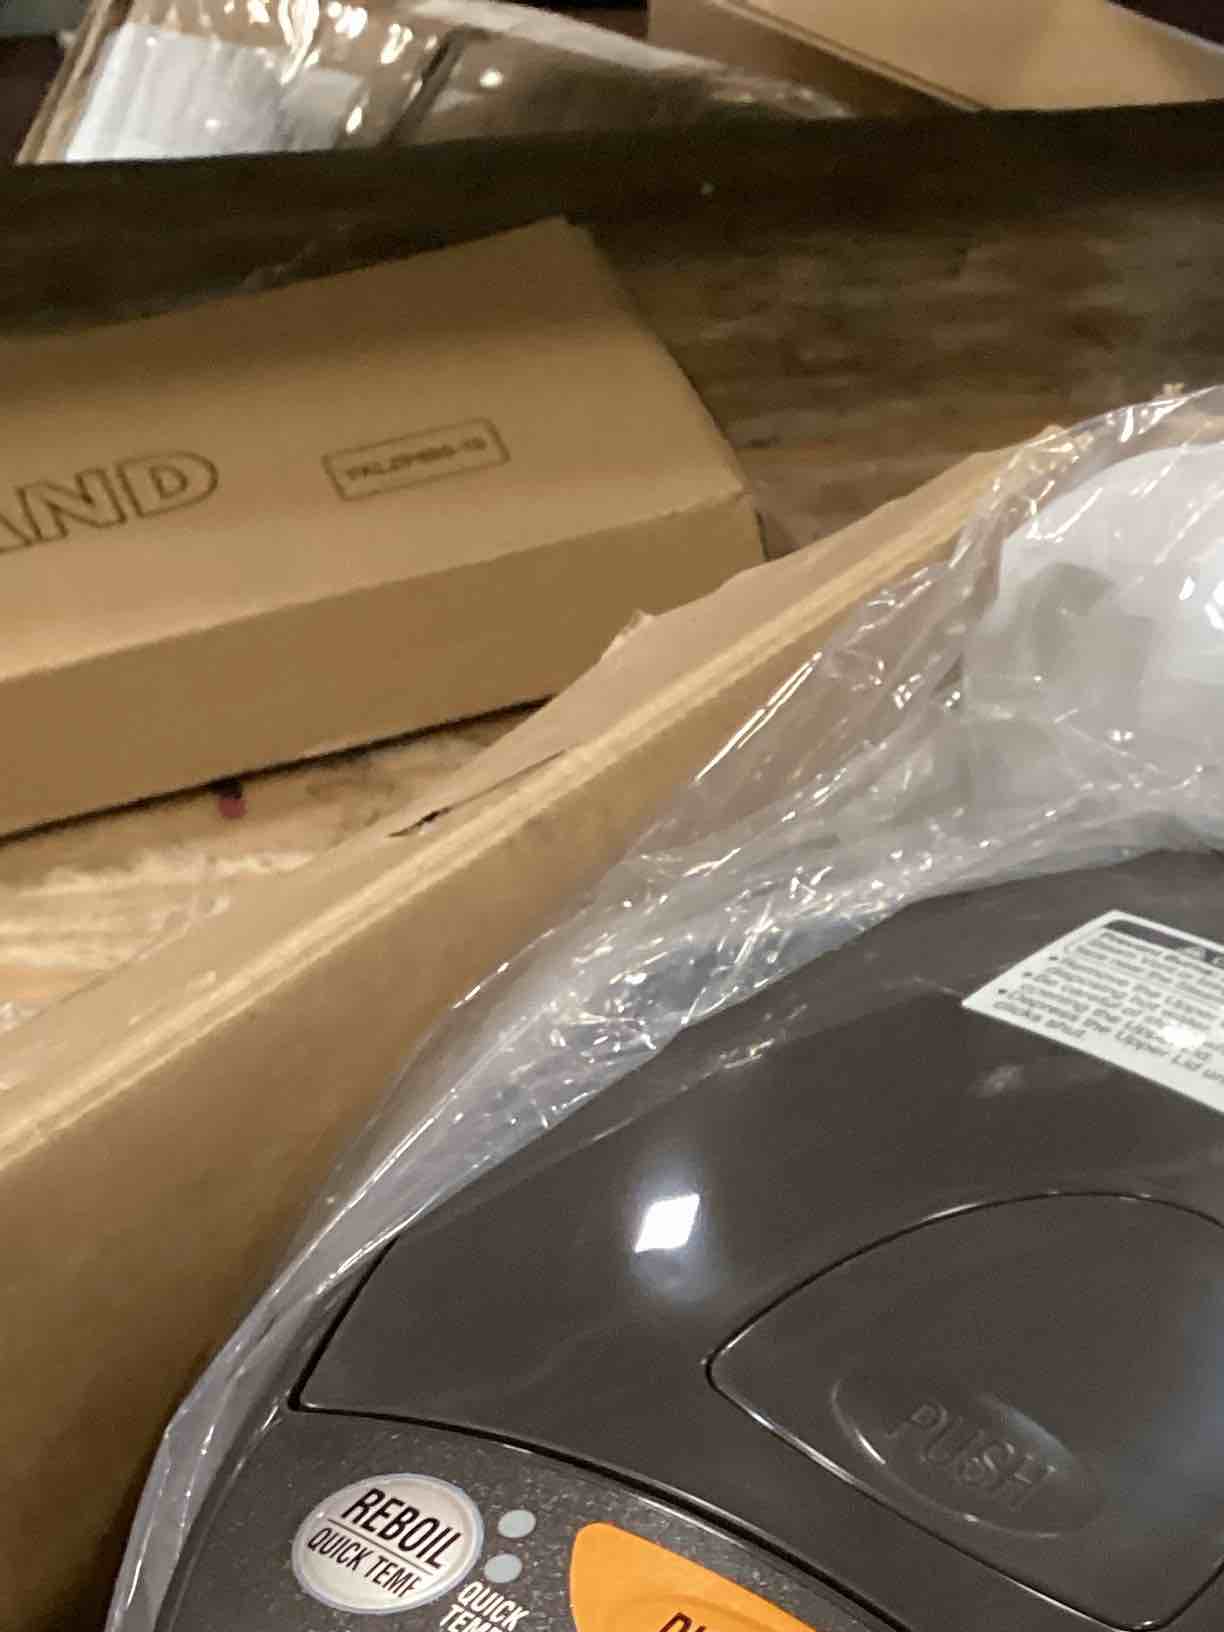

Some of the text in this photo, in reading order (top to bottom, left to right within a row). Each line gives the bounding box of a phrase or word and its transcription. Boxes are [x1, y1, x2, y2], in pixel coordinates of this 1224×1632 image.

[308, 1527, 365, 1571] QUICK
[342, 1488, 461, 1570] REBOIL
[457, 1581, 530, 1632] QUICK
